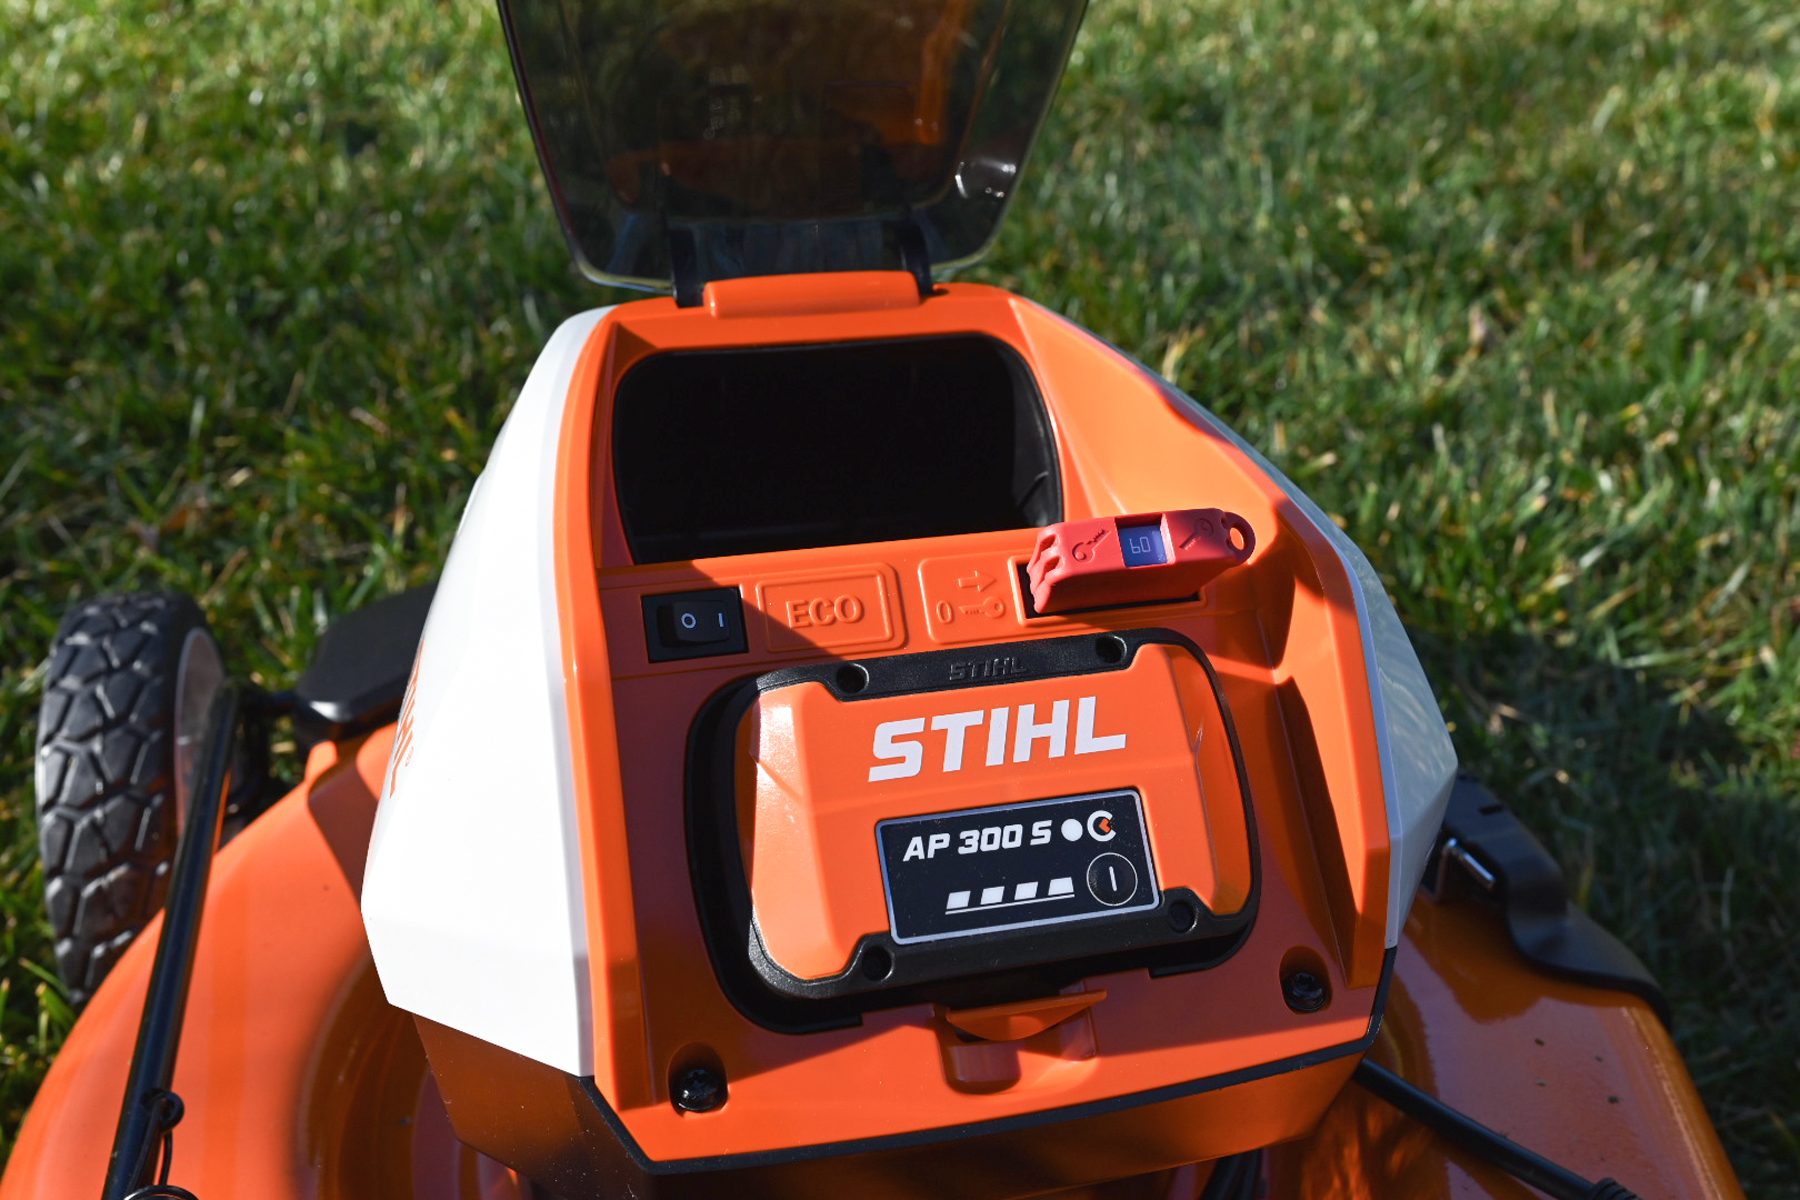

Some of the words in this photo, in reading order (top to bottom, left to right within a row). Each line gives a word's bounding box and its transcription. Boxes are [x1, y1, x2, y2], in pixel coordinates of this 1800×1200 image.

[786, 594, 865, 629] ECO
[949, 657, 1027, 681] STIHL
[869, 695, 1127, 782] STIHL
[902, 832, 951, 862] AP
[957, 823, 1024, 855] 300
[1030, 819, 1053, 846] S
